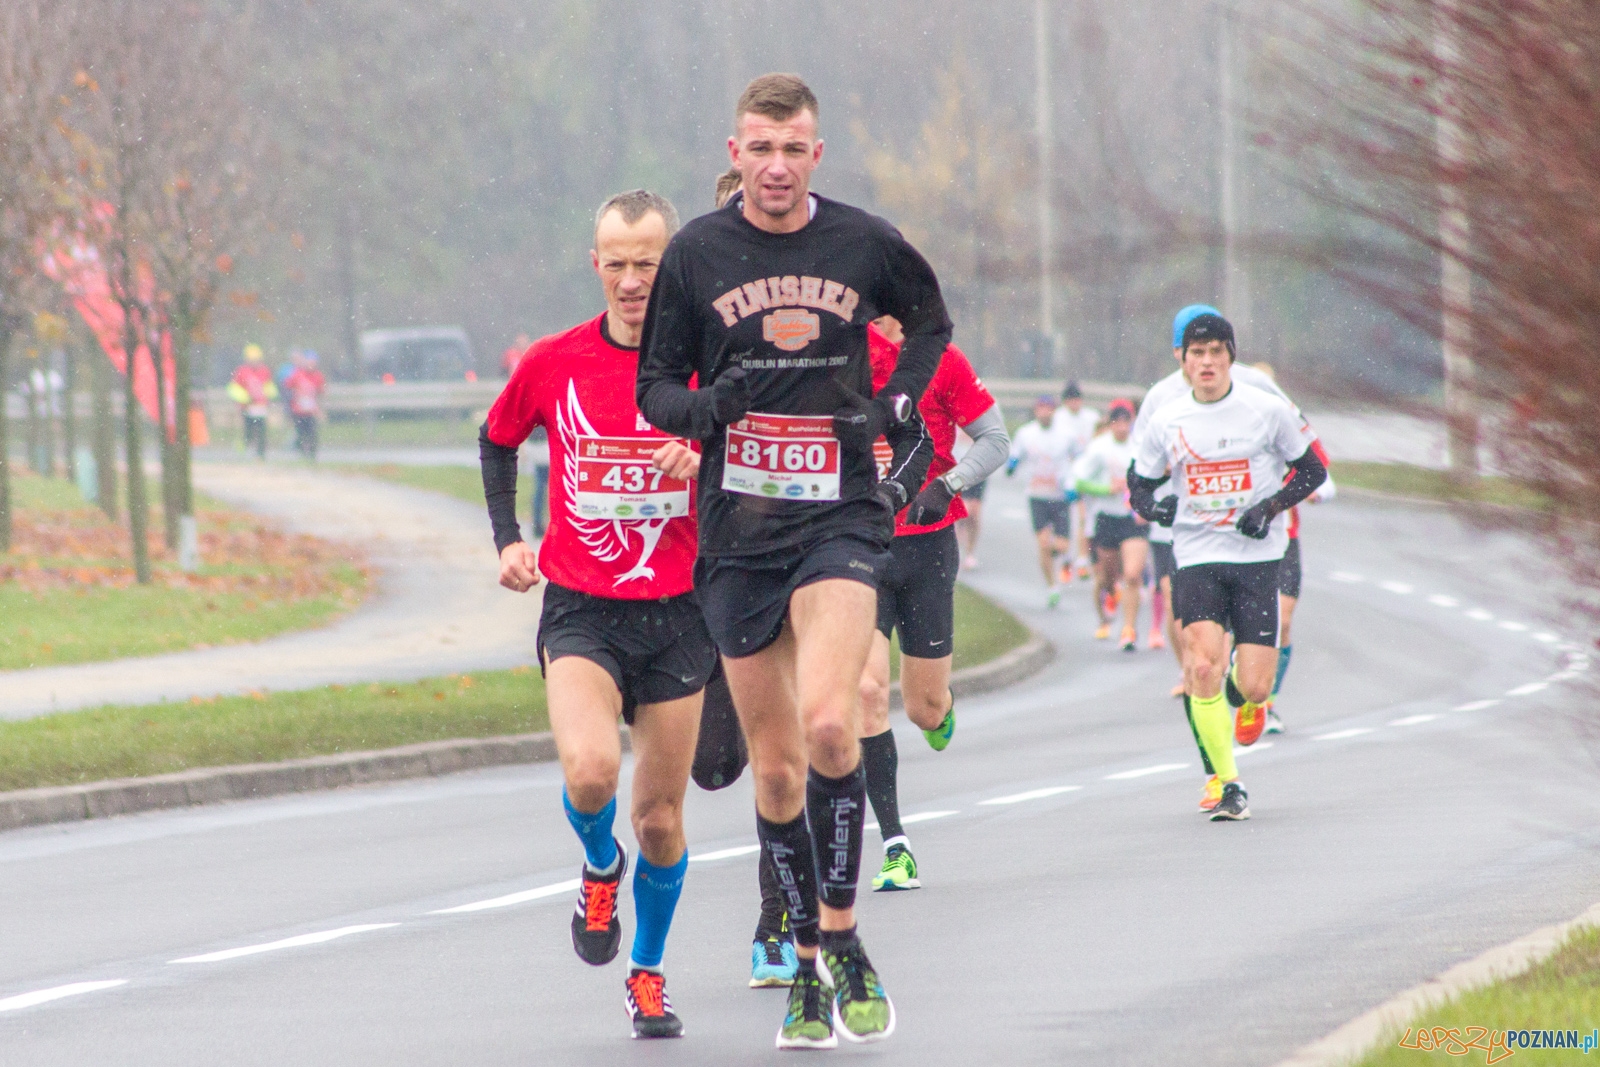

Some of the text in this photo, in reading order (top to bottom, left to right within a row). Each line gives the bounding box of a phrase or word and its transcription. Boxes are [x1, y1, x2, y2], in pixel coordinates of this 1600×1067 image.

[712, 275, 860, 328] FINISHER
[741, 355, 849, 369] DUBLIN MARATHON 2007
[729, 440, 826, 471] B 8160
[579, 465, 664, 492] B 437
[1195, 474, 1245, 494] 3457
